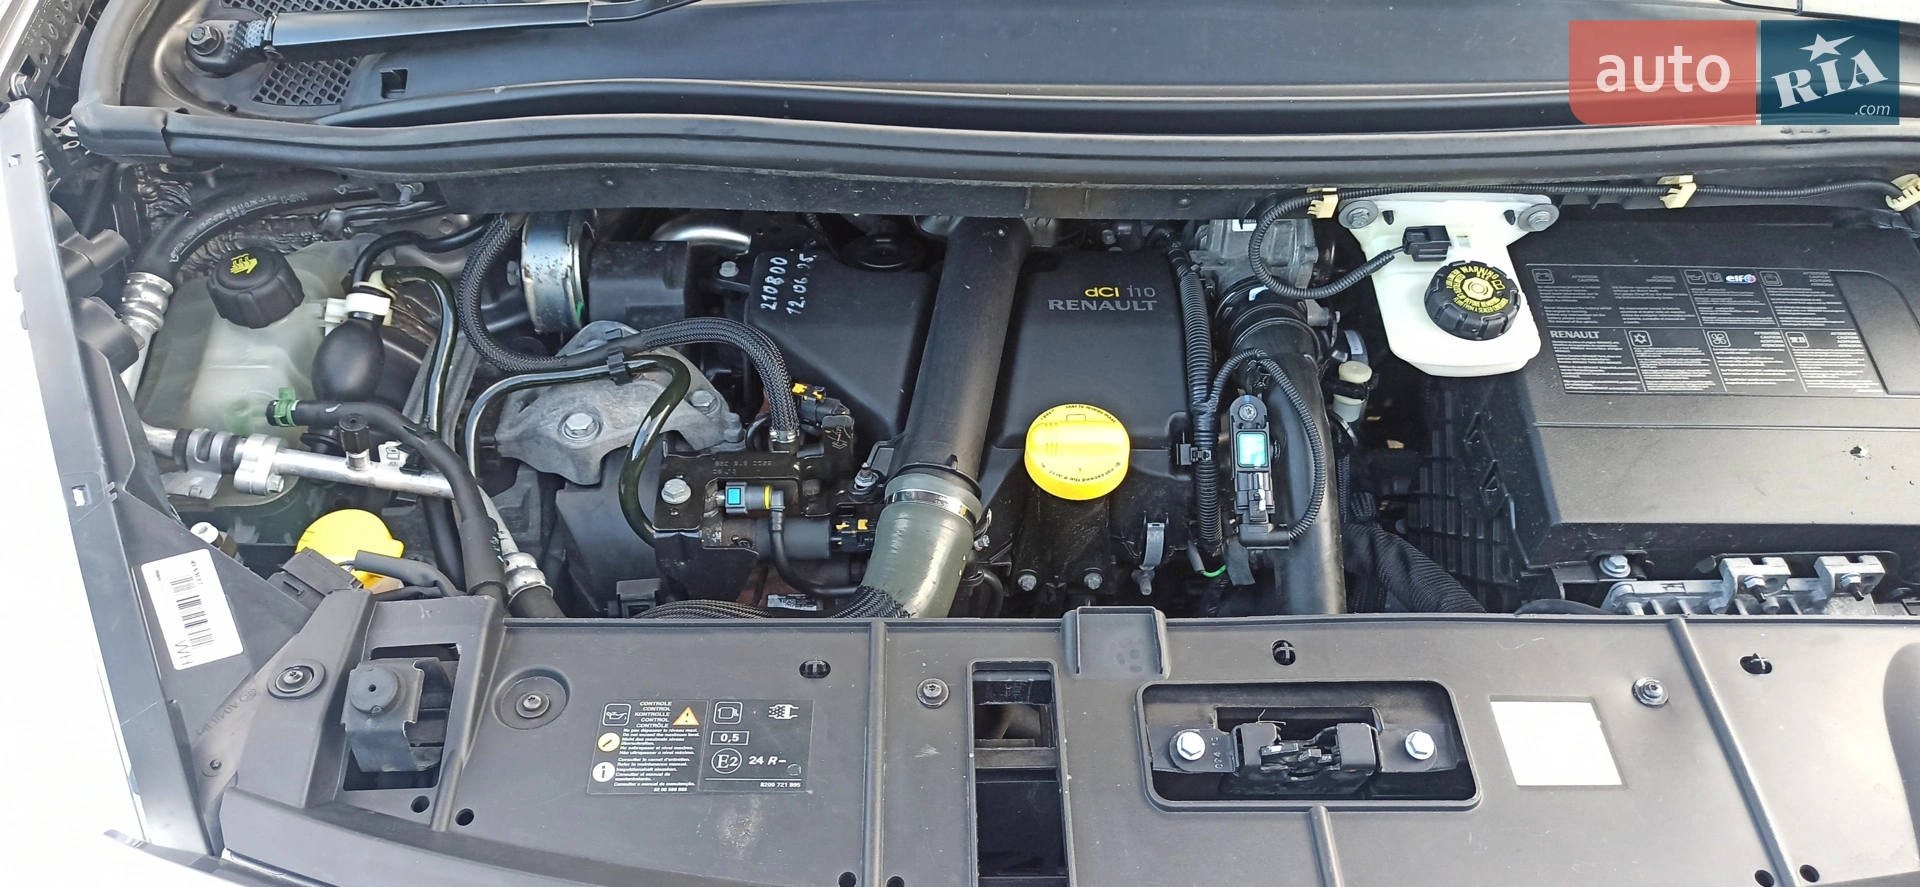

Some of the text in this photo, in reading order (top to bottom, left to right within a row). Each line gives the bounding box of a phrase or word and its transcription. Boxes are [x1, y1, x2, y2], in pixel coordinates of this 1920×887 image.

[1460, 266, 1499, 280] WARNING
[1725, 274, 1745, 282] elf
[760, 257, 788, 310] 210800
[1127, 285, 1156, 298] 110
[1048, 299, 1157, 311] RENAULT
[1550, 330, 1600, 339] RENAULT
[720, 733, 740, 743] 0,5
[716, 754, 739, 769] E2
[748, 756, 765, 765] 24
